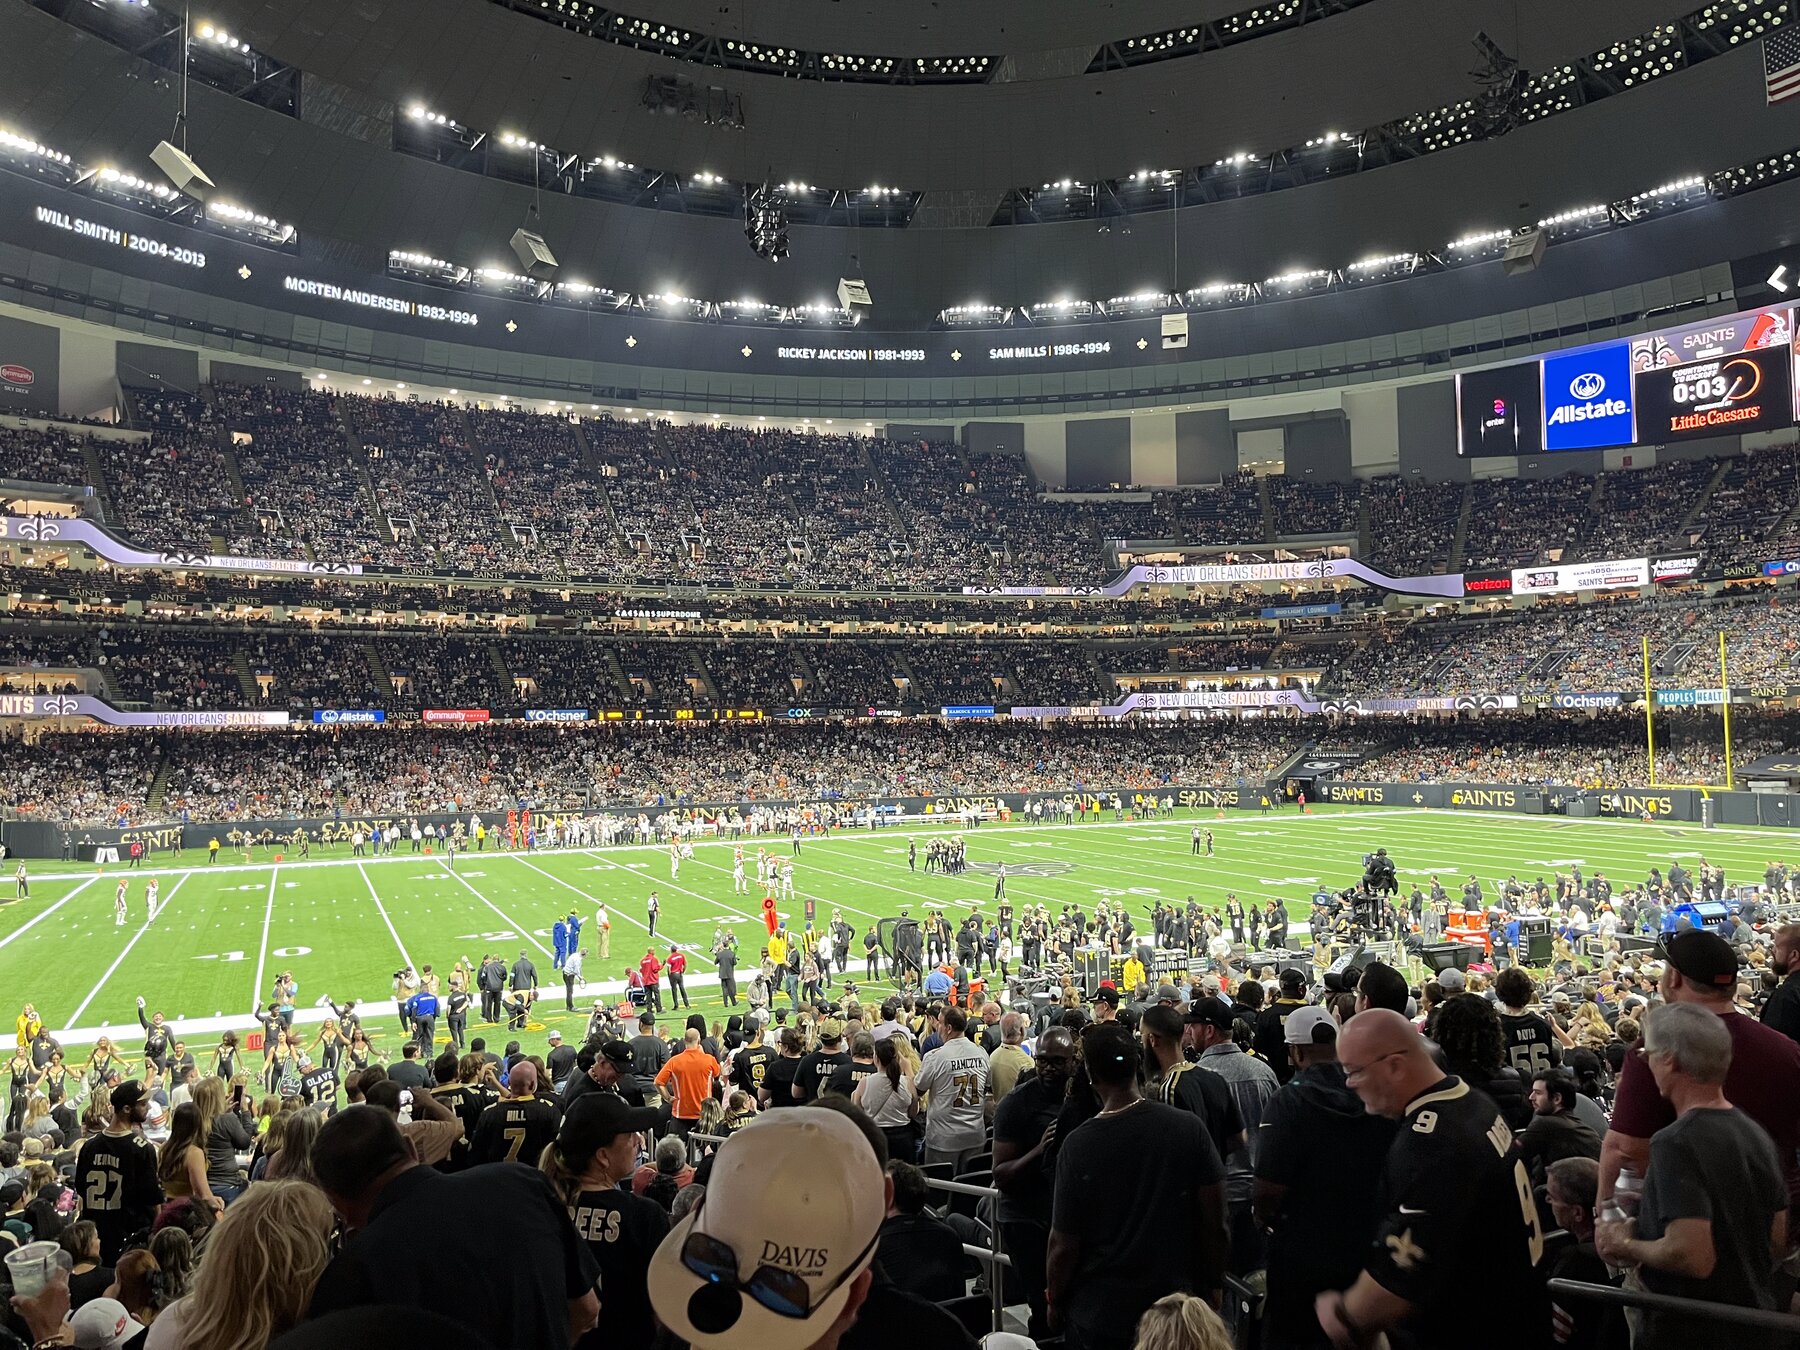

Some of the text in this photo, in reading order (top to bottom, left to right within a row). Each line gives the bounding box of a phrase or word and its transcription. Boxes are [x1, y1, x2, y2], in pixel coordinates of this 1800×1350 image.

[37, 206, 206, 267] WILL SMITH 2004-2013
[285, 276, 478, 326] MORTEN ANDERSEN 1982-1994
[1683, 327, 1735, 349] SAINTS
[778, 347, 925, 360] RICKEY JACKSON 1981-1993
[990, 341, 1110, 359] SAM MILLS 1986-1994
[1672, 362, 1719, 378] COUNTDOWN
[1675, 370, 1718, 384] TO KICKOFF
[1672, 376, 1727, 403] 0:03
[1670, 406, 1760, 432] Little Caesars
[220, 558, 236, 566] NEW
[238, 560, 271, 569] ORLEANS
[401, 567, 434, 576] SAINTS
[473, 571, 504, 580] SAINTS
[1172, 565, 1300, 582] NEW ORLEANS SAINTS
[1723, 565, 1757, 576] SAINTS
[541, 574, 572, 583] SAINTS
[608, 577, 637, 585] SAINTS
[1578, 578, 1603, 588] SAINTS
[733, 581, 760, 589] SAINTS
[851, 584, 877, 592] SAINTS
[908, 585, 935, 593] SAINTS
[1466, 578, 1510, 591] verizon
[69, 588, 106, 598] SAINTS
[150, 593, 187, 602] SAINTS
[227, 596, 261, 605] SAINTS
[302, 599, 334, 608] SAINTS
[371, 602, 402, 610] SAINTS
[438, 604, 468, 613] SAINTS
[502, 607, 531, 615] SAINTS
[1306, 606, 1328, 614] LOUNGE
[564, 608, 593, 616] SAINTS
[615, 609, 701, 619] CAESARS SUPERDOME
[726, 612, 752, 620] SAINTS
[783, 613, 807, 621] SAINTS
[1155, 612, 1180, 620] SAINTS
[1212, 610, 1237, 618] SAINTS
[836, 614, 860, 622] SAINTS
[889, 614, 913, 622] SAINTS
[942, 614, 966, 622] SAINTS
[995, 614, 1019, 622] SAINTS
[1048, 614, 1072, 622] SAINTS
[1100, 614, 1125, 622] SAINTS
[1751, 687, 1787, 697] SAINTS
[1159, 691, 1271, 706] NEW ORLEANS SAINTS
[1521, 695, 1551, 704] SAINTS
[1563, 693, 1618, 708] Ochsner
[1658, 691, 1694, 704] PEOPLES
[1382, 699, 1416, 711] ORLEANS
[1417, 698, 1446, 710] SAINTS
[387, 711, 419, 720] SAINTS
[427, 710, 465, 723] Community
[536, 710, 585, 722] Ochsner
[788, 708, 812, 718] COX
[828, 708, 855, 716] SAINTS
[876, 709, 902, 718] entergy
[1026, 706, 1099, 717] NEW ORLEANS SAINTS
[157, 713, 265, 725] NEW ORLEANS SAINTS
[1516, 1028, 1536, 1041] DAVIS
[1510, 1042, 1551, 1075] 56
[306, 1070, 334, 1087] OLAVE
[310, 1080, 336, 1104] 12
[953, 1074, 980, 1108] 71
[506, 1110, 526, 1122] HILL
[1412, 1110, 1438, 1134] 9
[504, 1127, 526, 1163] 7
[86, 1170, 123, 1211] 27
[762, 1240, 828, 1268] DAVIS
